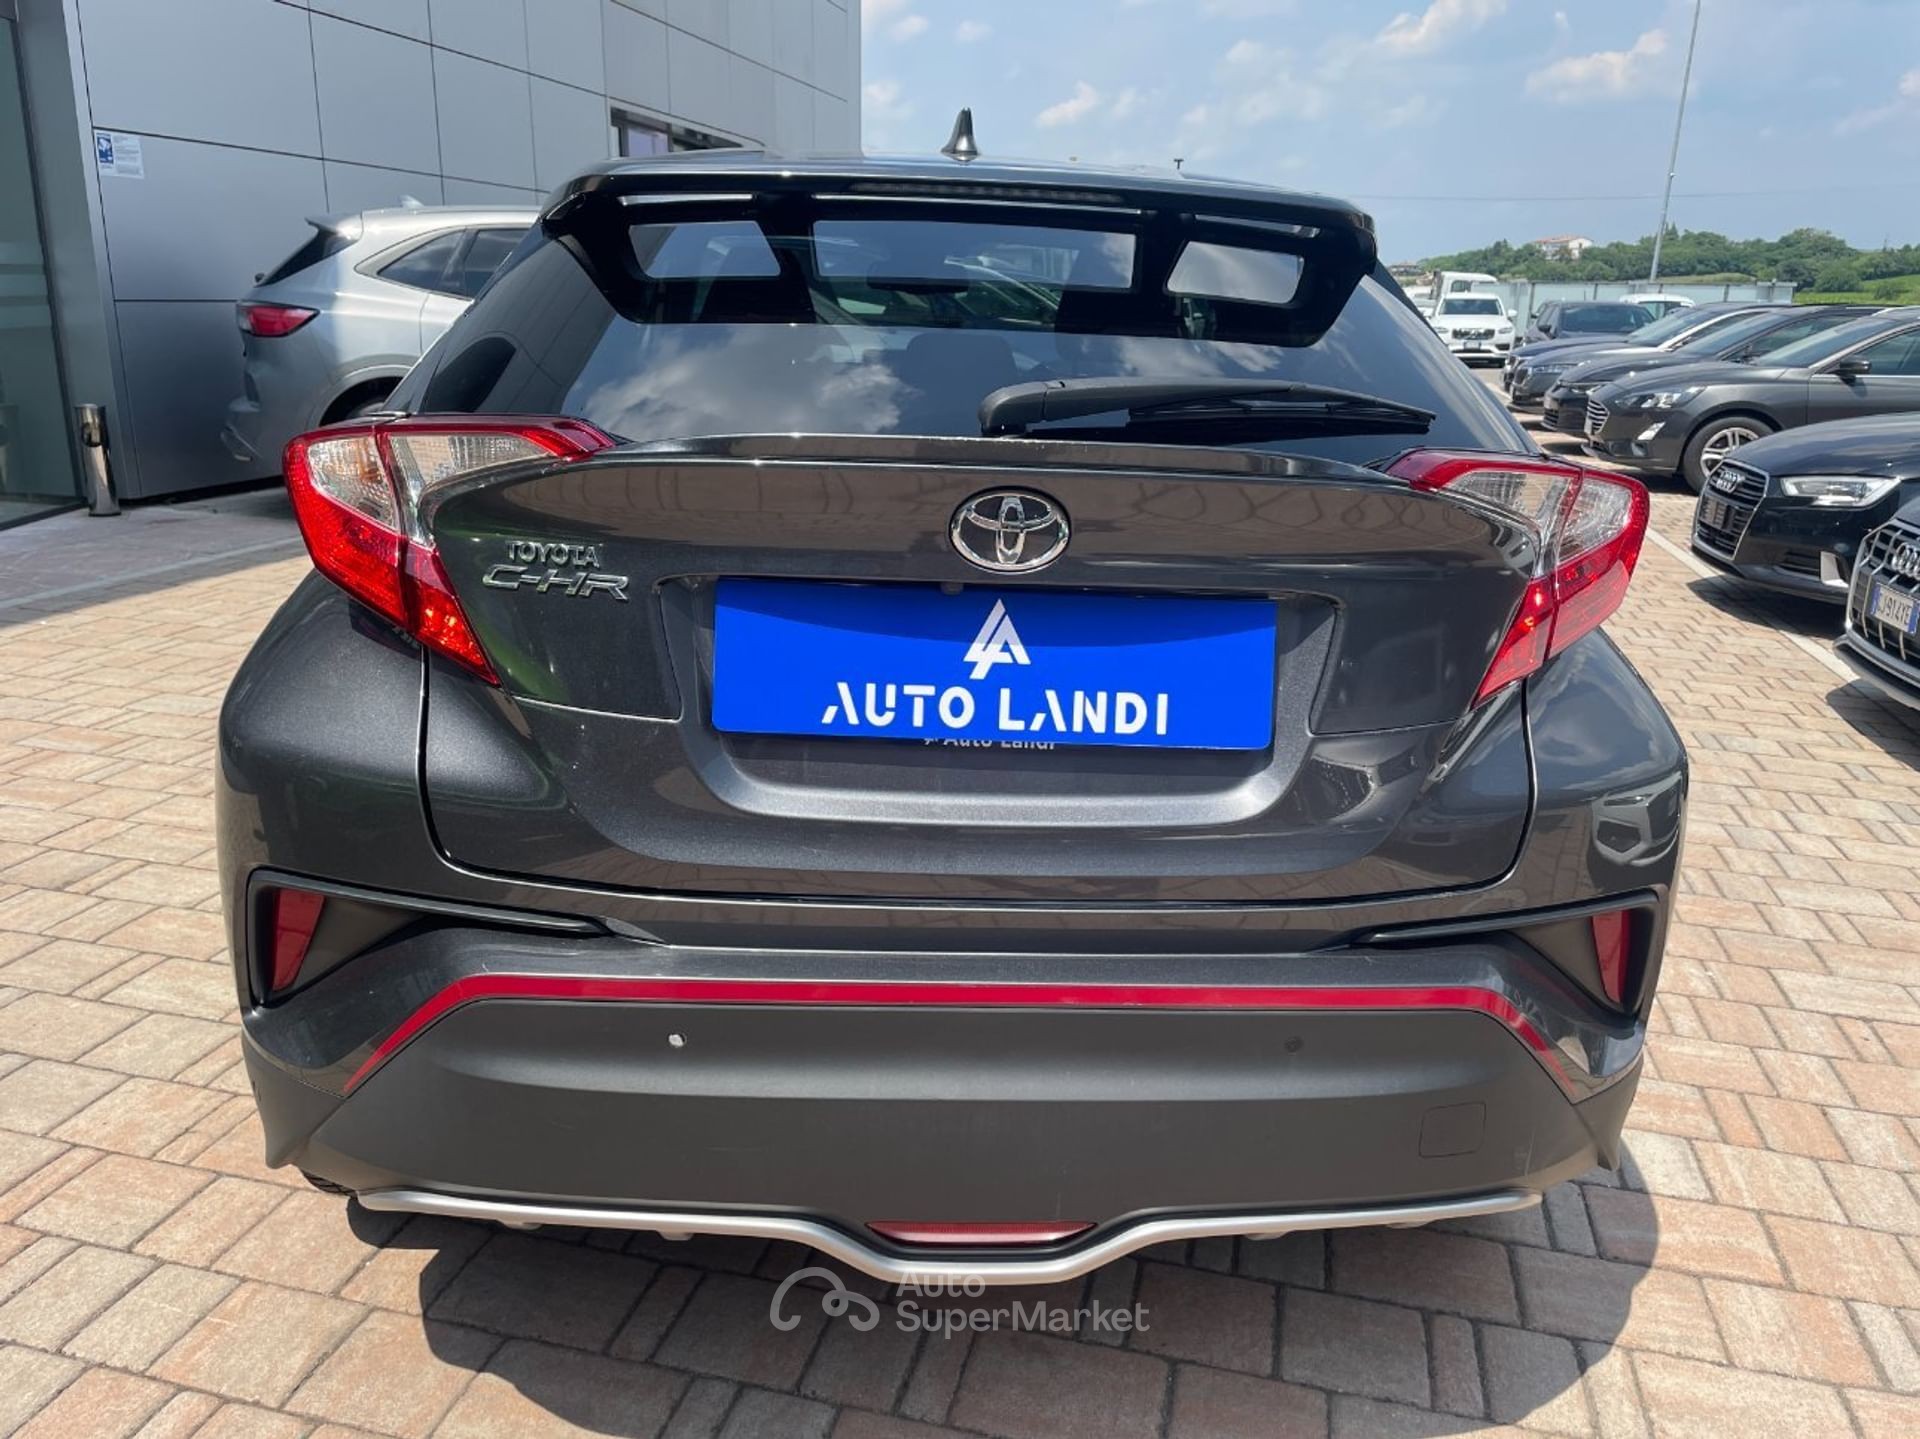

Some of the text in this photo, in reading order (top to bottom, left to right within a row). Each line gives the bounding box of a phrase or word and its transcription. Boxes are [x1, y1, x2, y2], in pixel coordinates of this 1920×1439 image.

[506, 540, 600, 567] TOYOTA
[482, 564, 629, 600] C-HR
[821, 682, 1169, 735] AUTO LANDI
